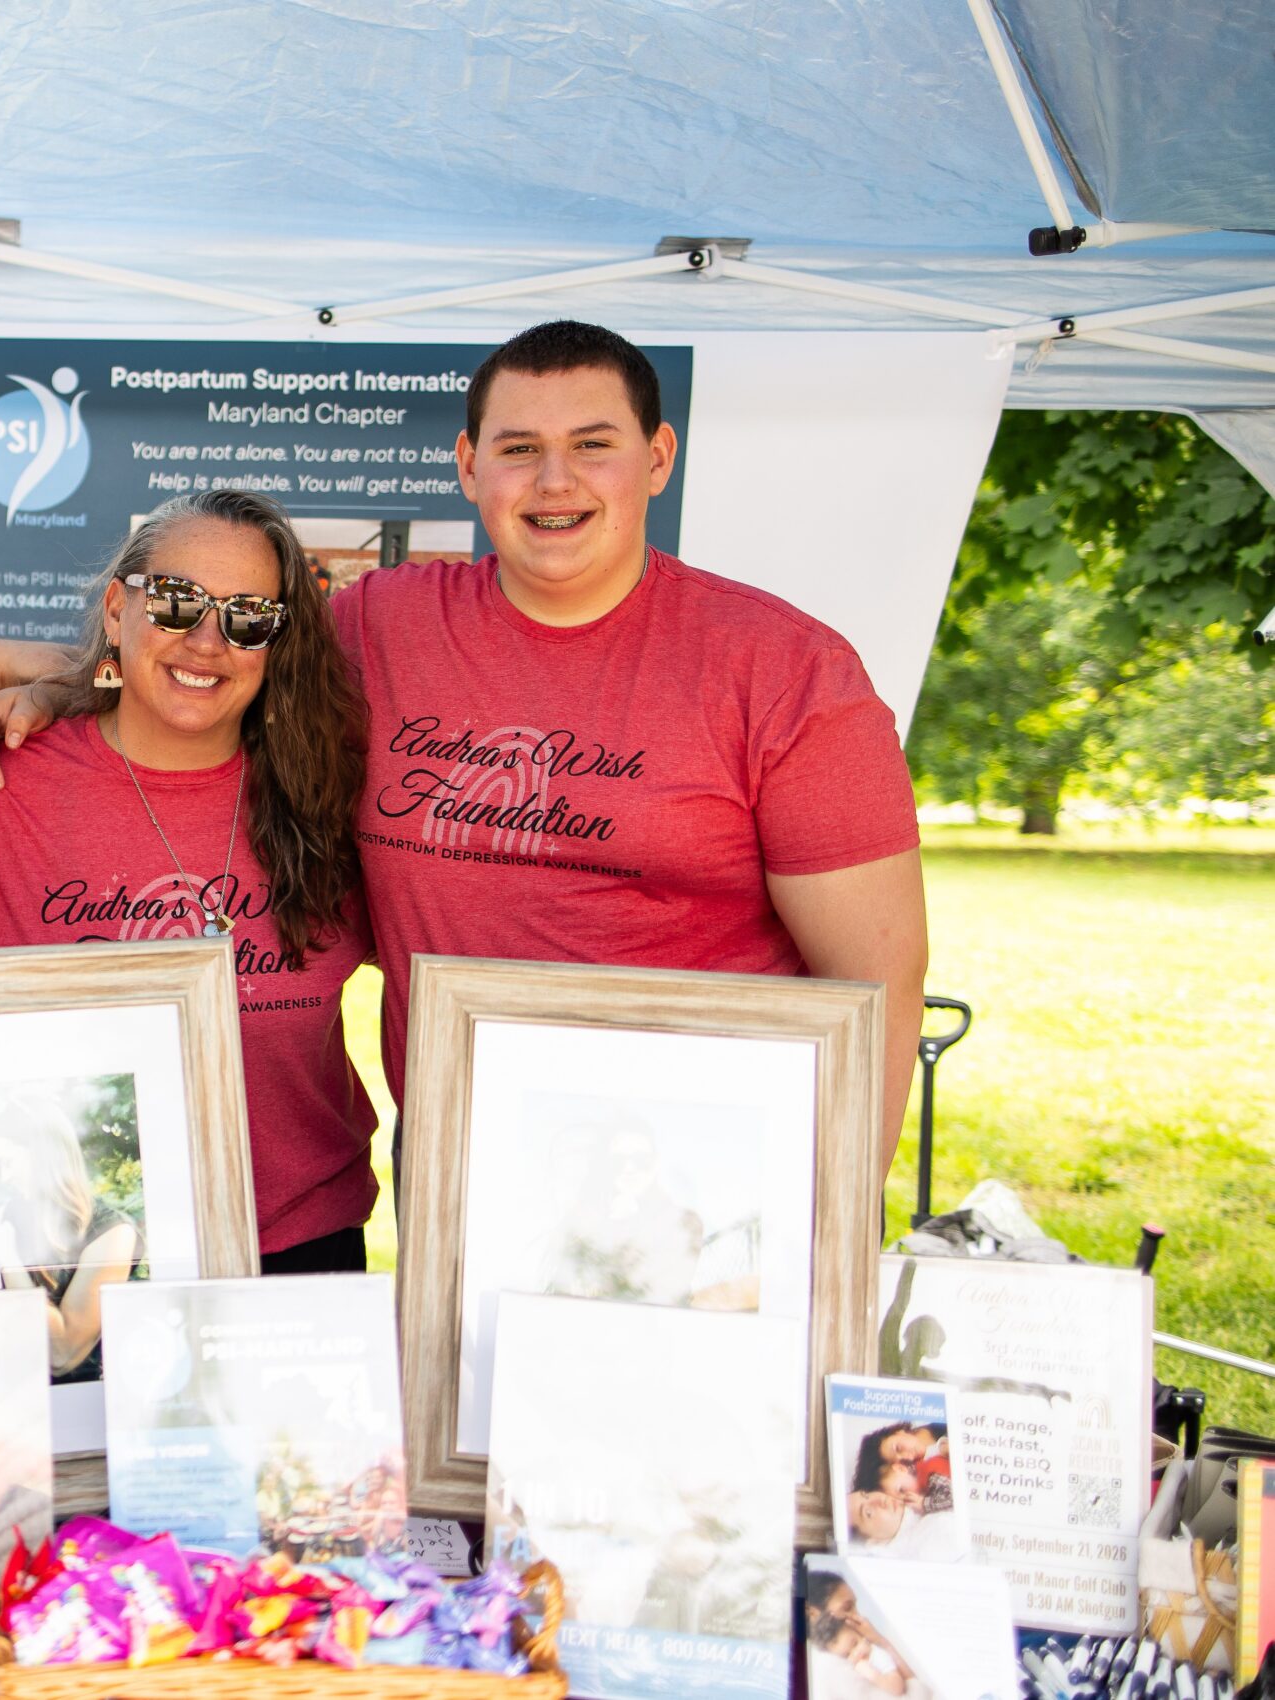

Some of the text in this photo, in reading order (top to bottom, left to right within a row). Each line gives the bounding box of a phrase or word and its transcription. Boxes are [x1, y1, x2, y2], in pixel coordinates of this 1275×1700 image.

[110, 366, 472, 394] Postpartum Support Internatio
[207, 401, 407, 428] Maryland Chapter
[131, 442, 165, 461] You
[168, 446, 197, 461] are
[201, 444, 232, 461] not
[234, 444, 288, 461] alone.
[293, 445, 328, 463] You
[330, 448, 359, 463] are
[363, 447, 393, 463] not
[399, 447, 418, 464] to
[148, 472, 459, 496] Help is available. You will get better.
[15, 513, 86, 528] Maryland
[3, 571, 27, 586] the
[30, 571, 53, 586] PSI
[8, 621, 21, 636] in
[389, 716, 646, 780] Andrea's Wish
[377, 768, 616, 842] Foundation
[356, 831, 643, 879] POSTPARTUM DEPRESSION AWARENESS
[41, 880, 190, 925] Andrea's
[239, 996, 322, 1014] AWARENESS
[843, 1398, 944, 1418] Postpartum Families
[864, 1389, 922, 1406] Supporting
[995, 1417, 1053, 1436] Range,
[1013, 1456, 1051, 1472] BBQ
[999, 1473, 1054, 1490] Drinks
[985, 1490, 1032, 1506] More!
[1012, 1534, 1073, 1556] September
[1097, 1543, 1127, 1562] 2026
[1035, 1571, 1070, 1591] Manor
[1074, 1575, 1098, 1593] Golf
[1100, 1579, 1127, 1597] Club
[1027, 1592, 1126, 1621] 9:30 AM Shotgun
[560, 1626, 598, 1649] TEXT
